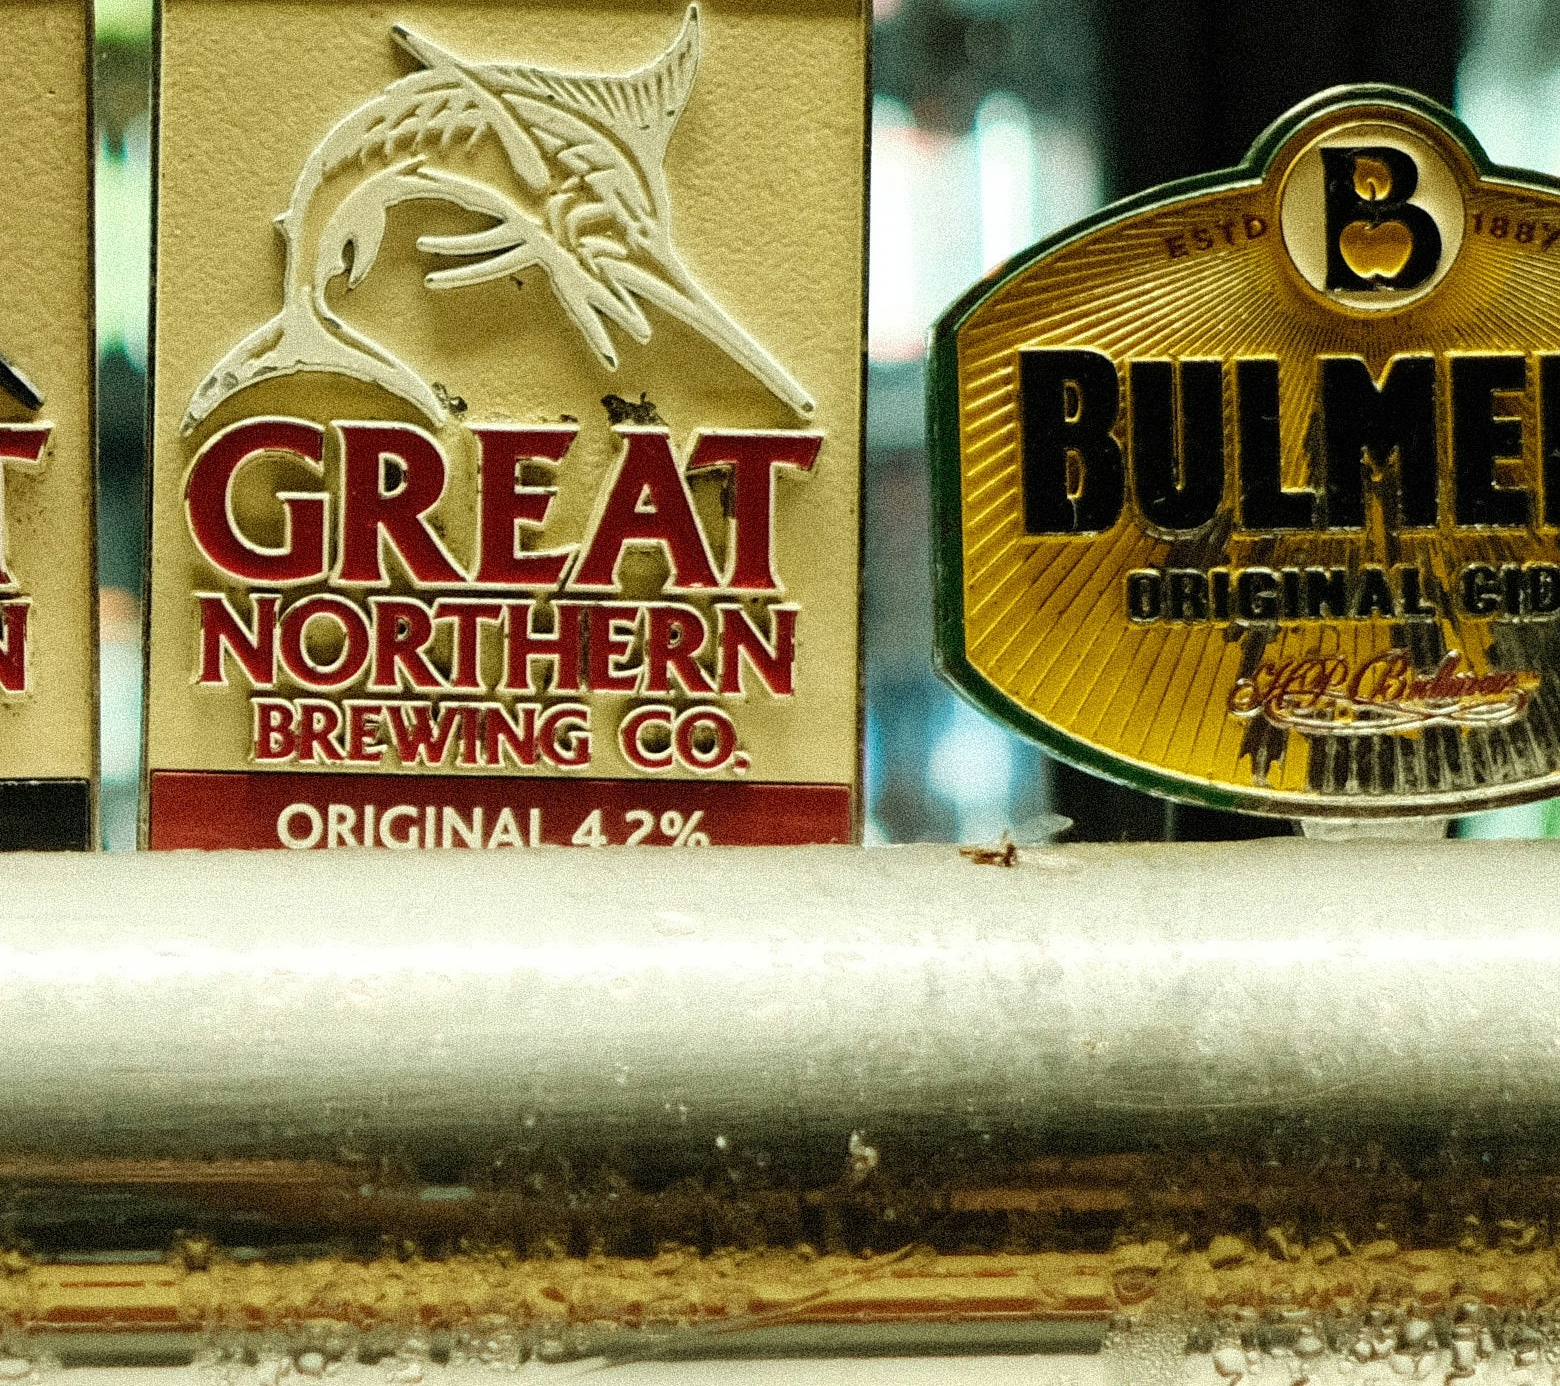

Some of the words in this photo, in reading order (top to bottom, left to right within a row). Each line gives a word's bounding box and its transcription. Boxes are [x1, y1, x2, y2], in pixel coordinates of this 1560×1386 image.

[1164, 217, 1269, 261] ESTD
[1319, 145, 1444, 293] B
[182, 416, 824, 593] GREAT
[1125, 564, 1437, 625] ORIGINAL
[194, 592, 801, 697] NORTHERN
[251, 697, 593, 770] BREWING
[617, 704, 752, 774] CO.
[570, 808, 711, 848] 42%
